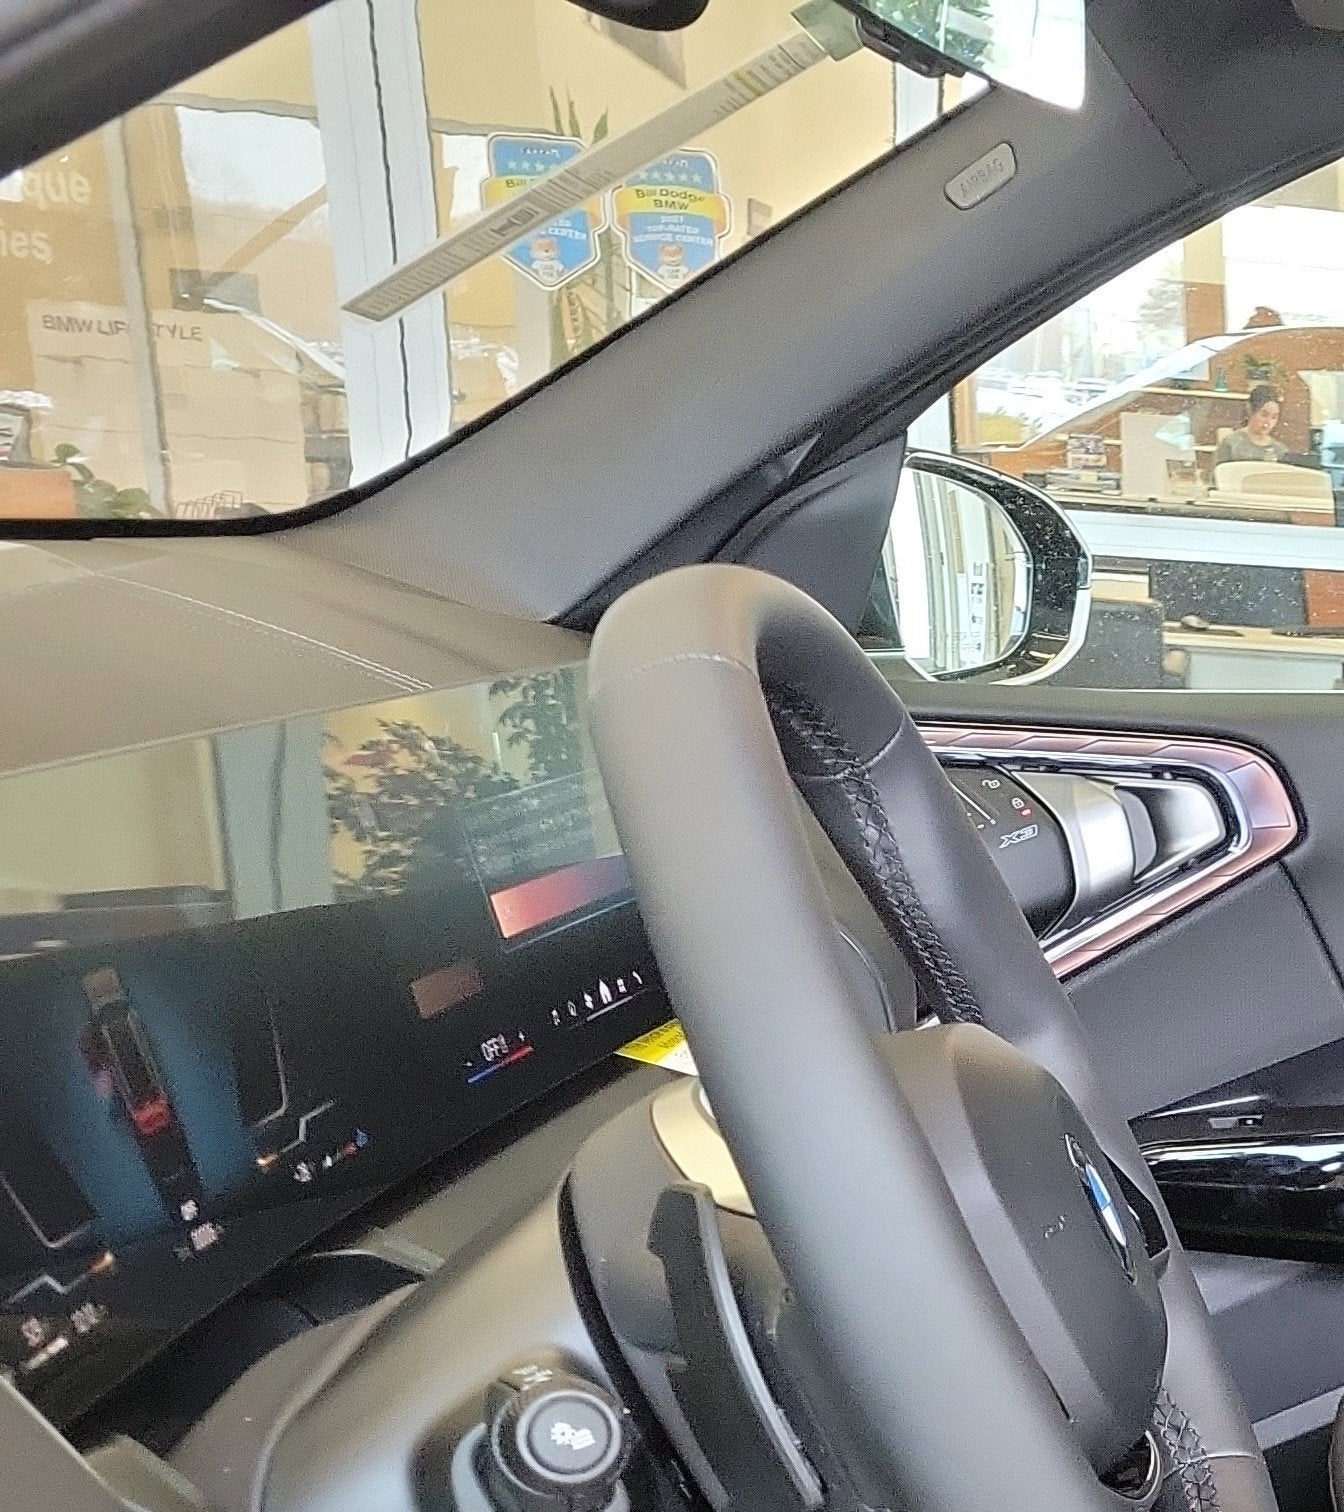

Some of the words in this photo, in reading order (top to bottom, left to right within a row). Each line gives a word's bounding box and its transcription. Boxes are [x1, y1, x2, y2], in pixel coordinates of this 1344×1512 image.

[653, 199, 690, 211] BMW
[42, 314, 93, 333] BMW
[97, 320, 203, 341] LIFTYLE
[999, 824, 1039, 849] X3
